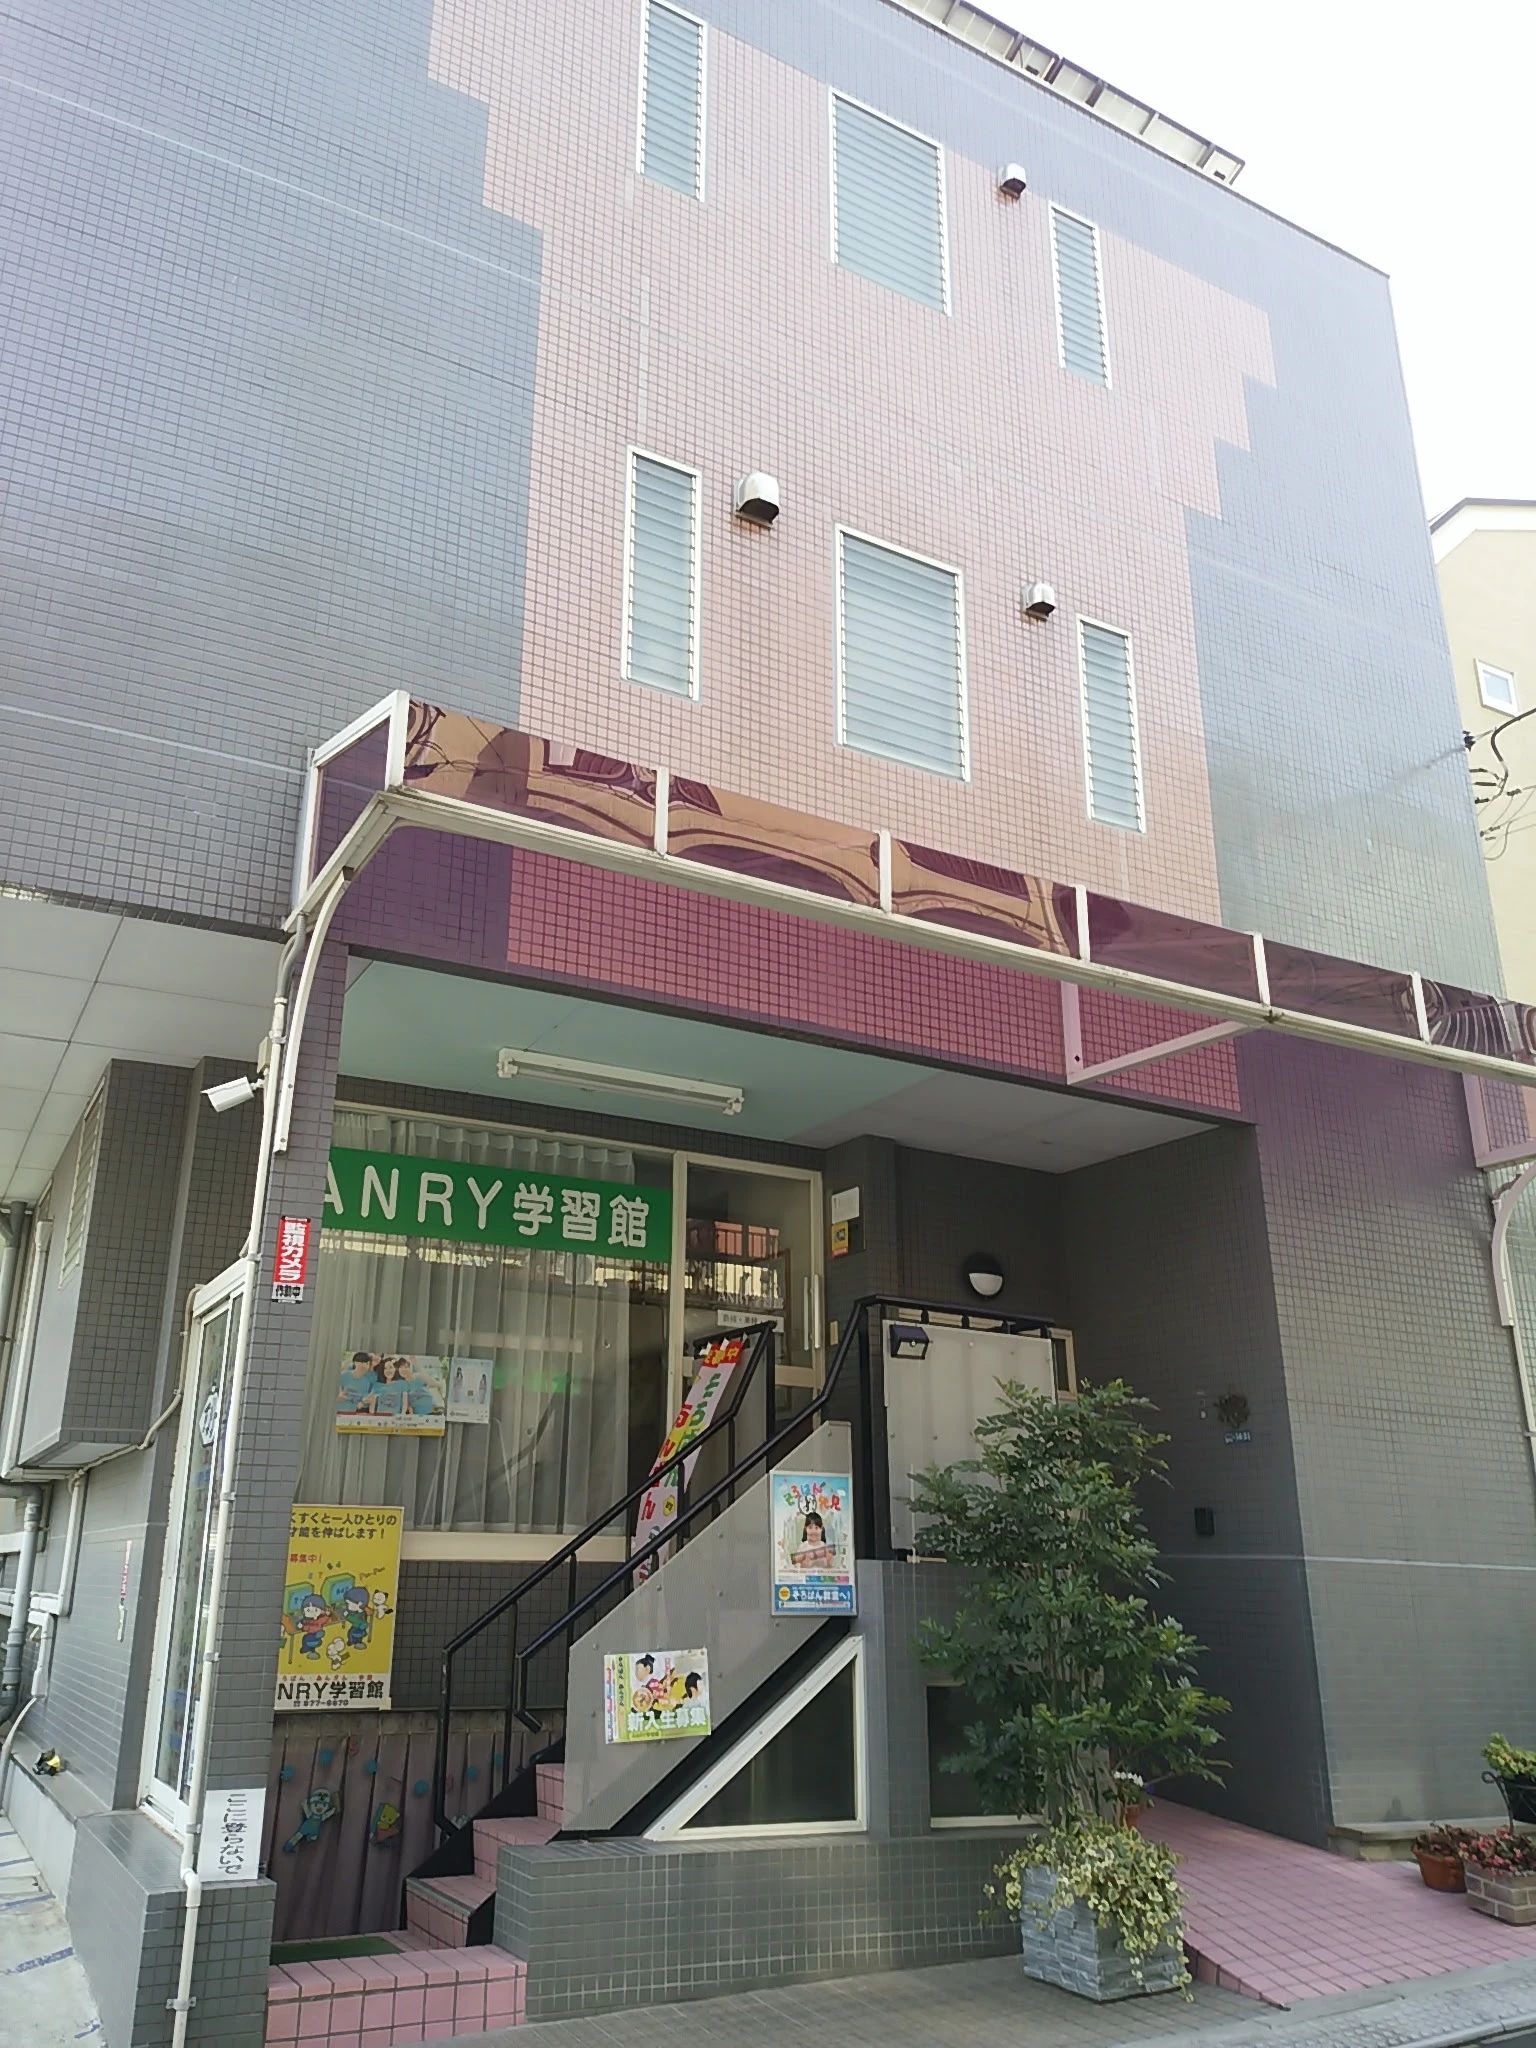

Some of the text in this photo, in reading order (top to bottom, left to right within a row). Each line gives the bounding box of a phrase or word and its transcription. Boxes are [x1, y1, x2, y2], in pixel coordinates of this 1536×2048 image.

[278, 1221, 307, 1281] 監視カメラ
[628, 1706, 707, 1732] 新入生募集
